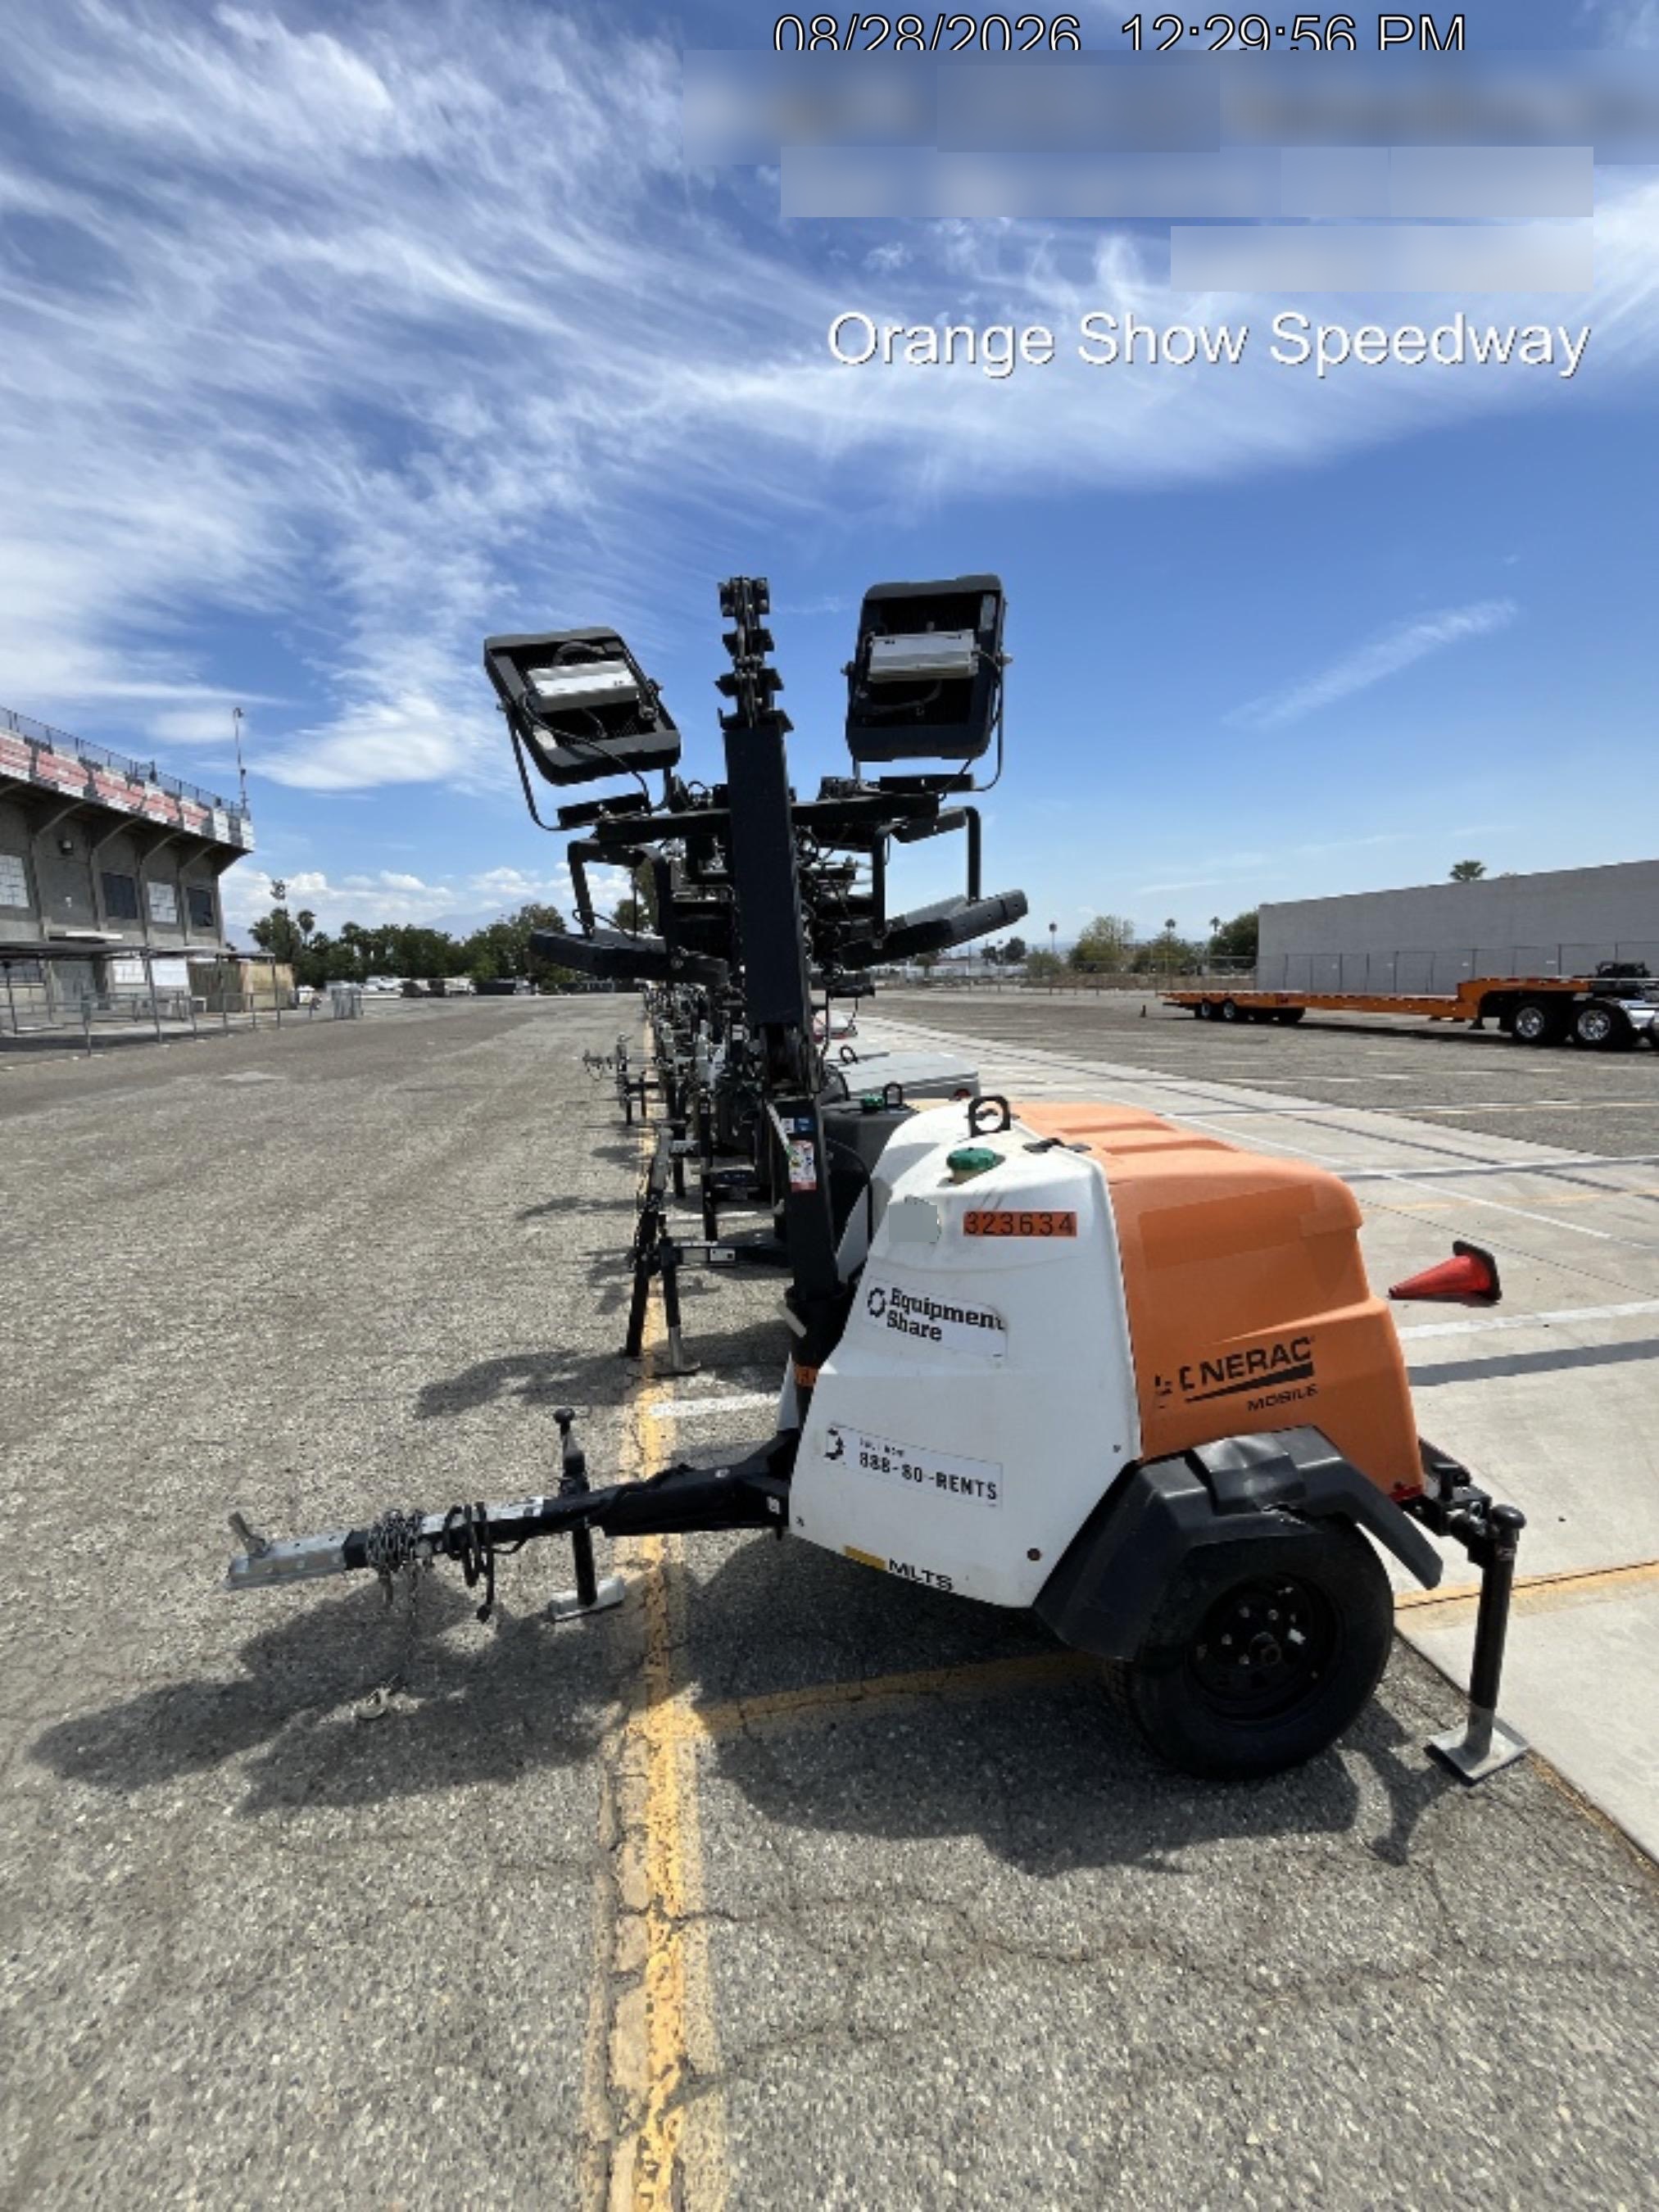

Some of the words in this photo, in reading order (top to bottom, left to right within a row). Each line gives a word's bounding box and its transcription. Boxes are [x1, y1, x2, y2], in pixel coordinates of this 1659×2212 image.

[965, 1212, 1074, 1235] 323634
[890, 1287, 1004, 1330] Equipment
[886, 1310, 942, 1341] Share
